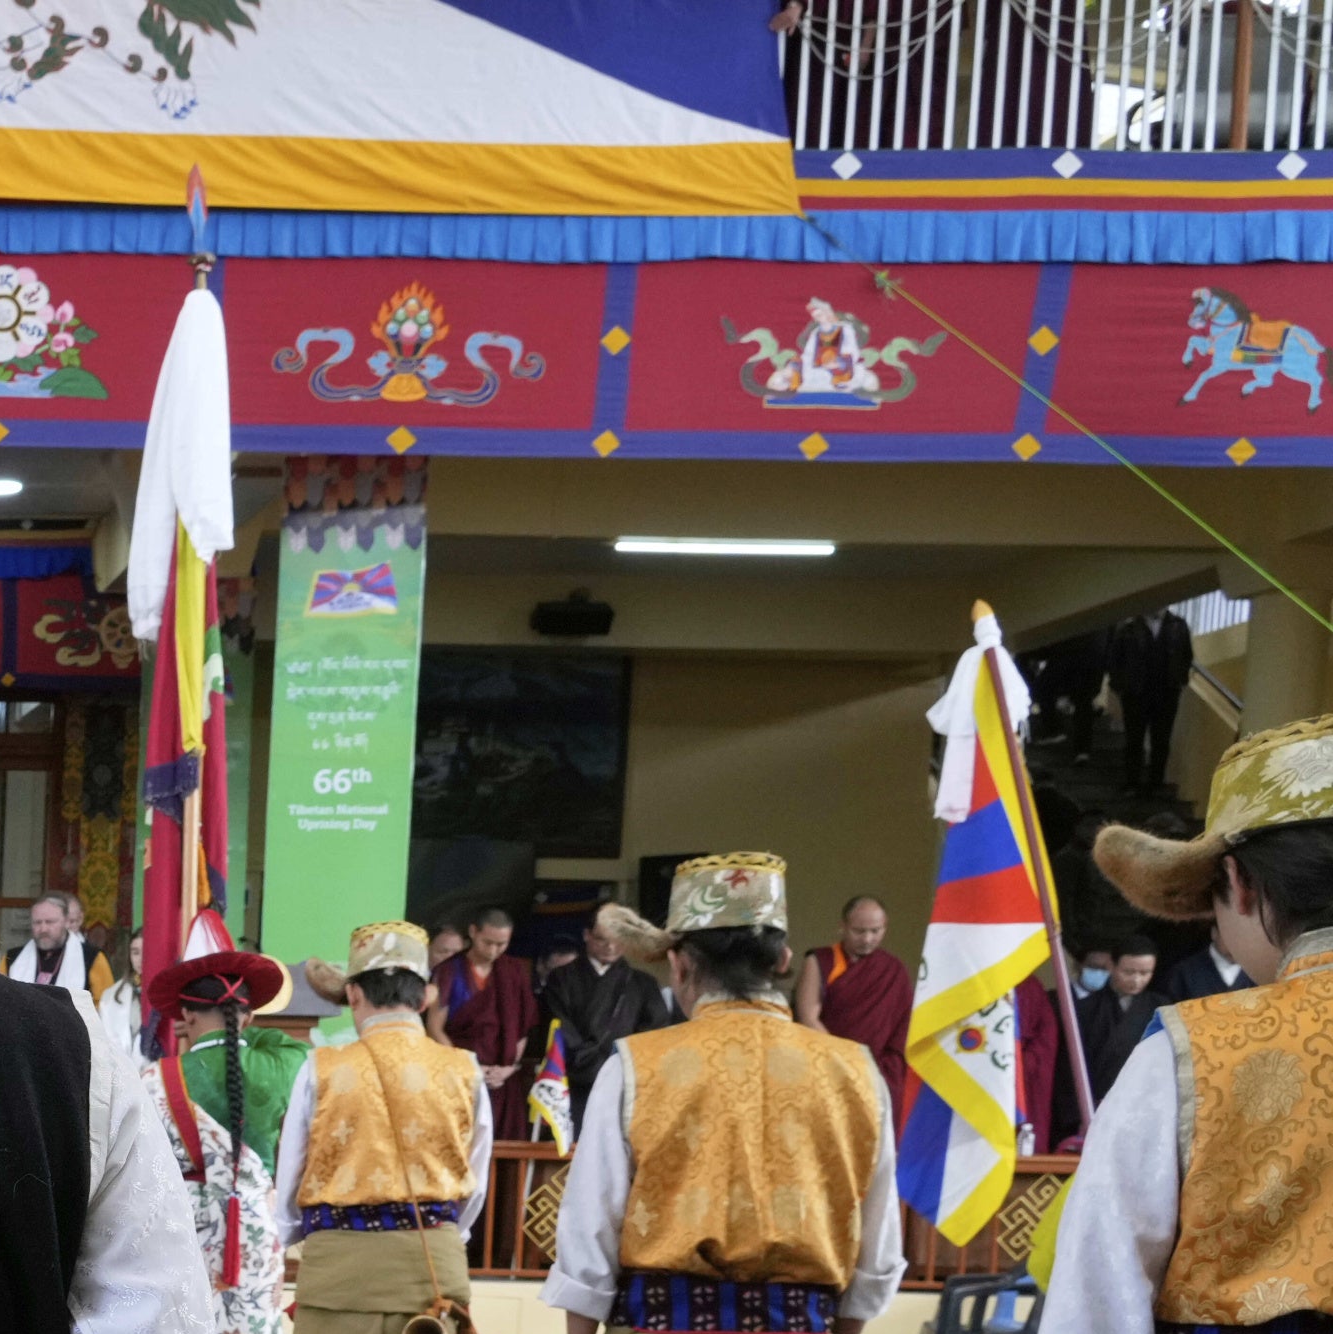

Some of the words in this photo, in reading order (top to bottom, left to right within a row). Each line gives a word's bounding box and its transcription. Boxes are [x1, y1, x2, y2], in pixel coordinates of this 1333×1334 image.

[313, 766, 373, 795] 66th
[287, 803, 334, 816] Tibetan
[336, 803, 389, 816] National
[297, 818, 351, 832] Uprising
[352, 818, 378, 831] Day
